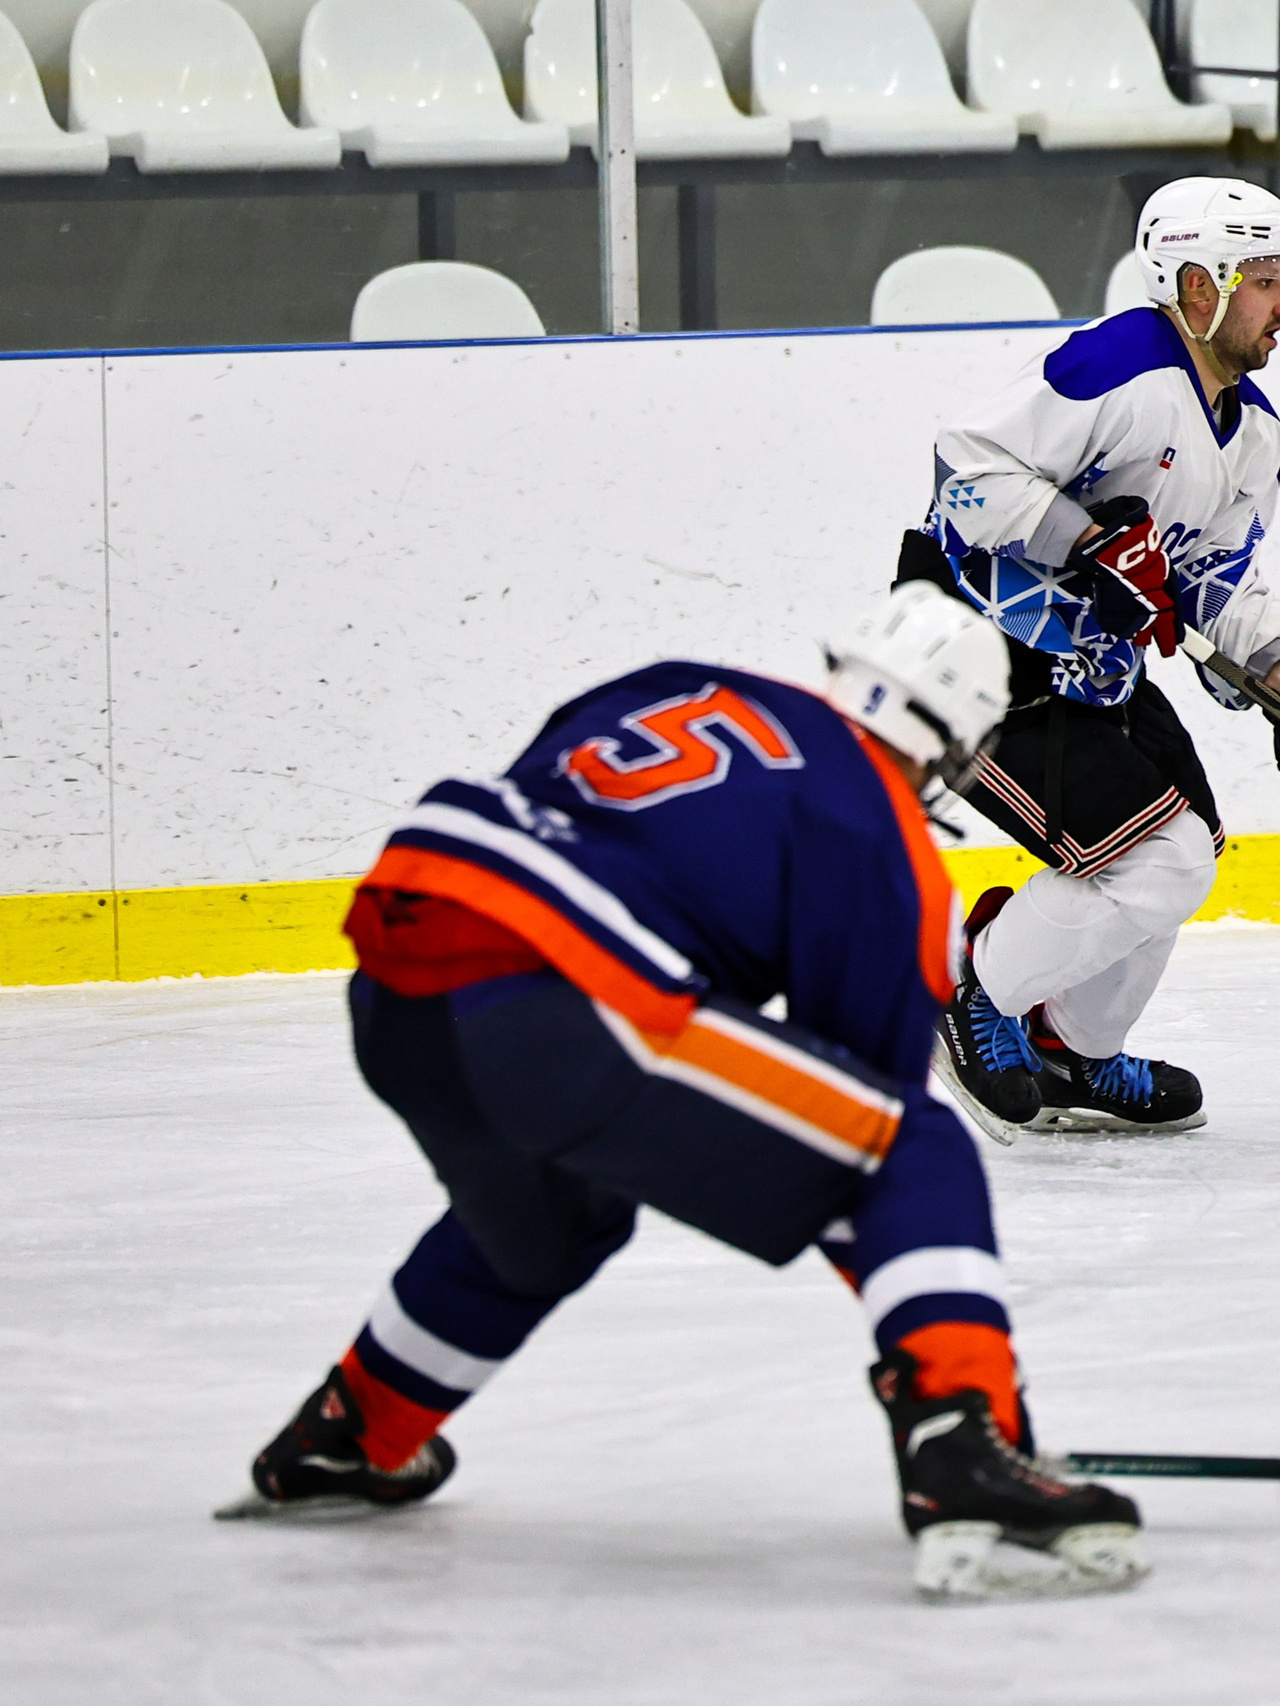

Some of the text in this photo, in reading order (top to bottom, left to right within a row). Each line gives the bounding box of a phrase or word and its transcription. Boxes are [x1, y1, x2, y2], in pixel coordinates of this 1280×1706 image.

[1161, 232, 1200, 243] BAUER
[555, 680, 806, 812] 5
[945, 1013, 967, 1066] BAUER
